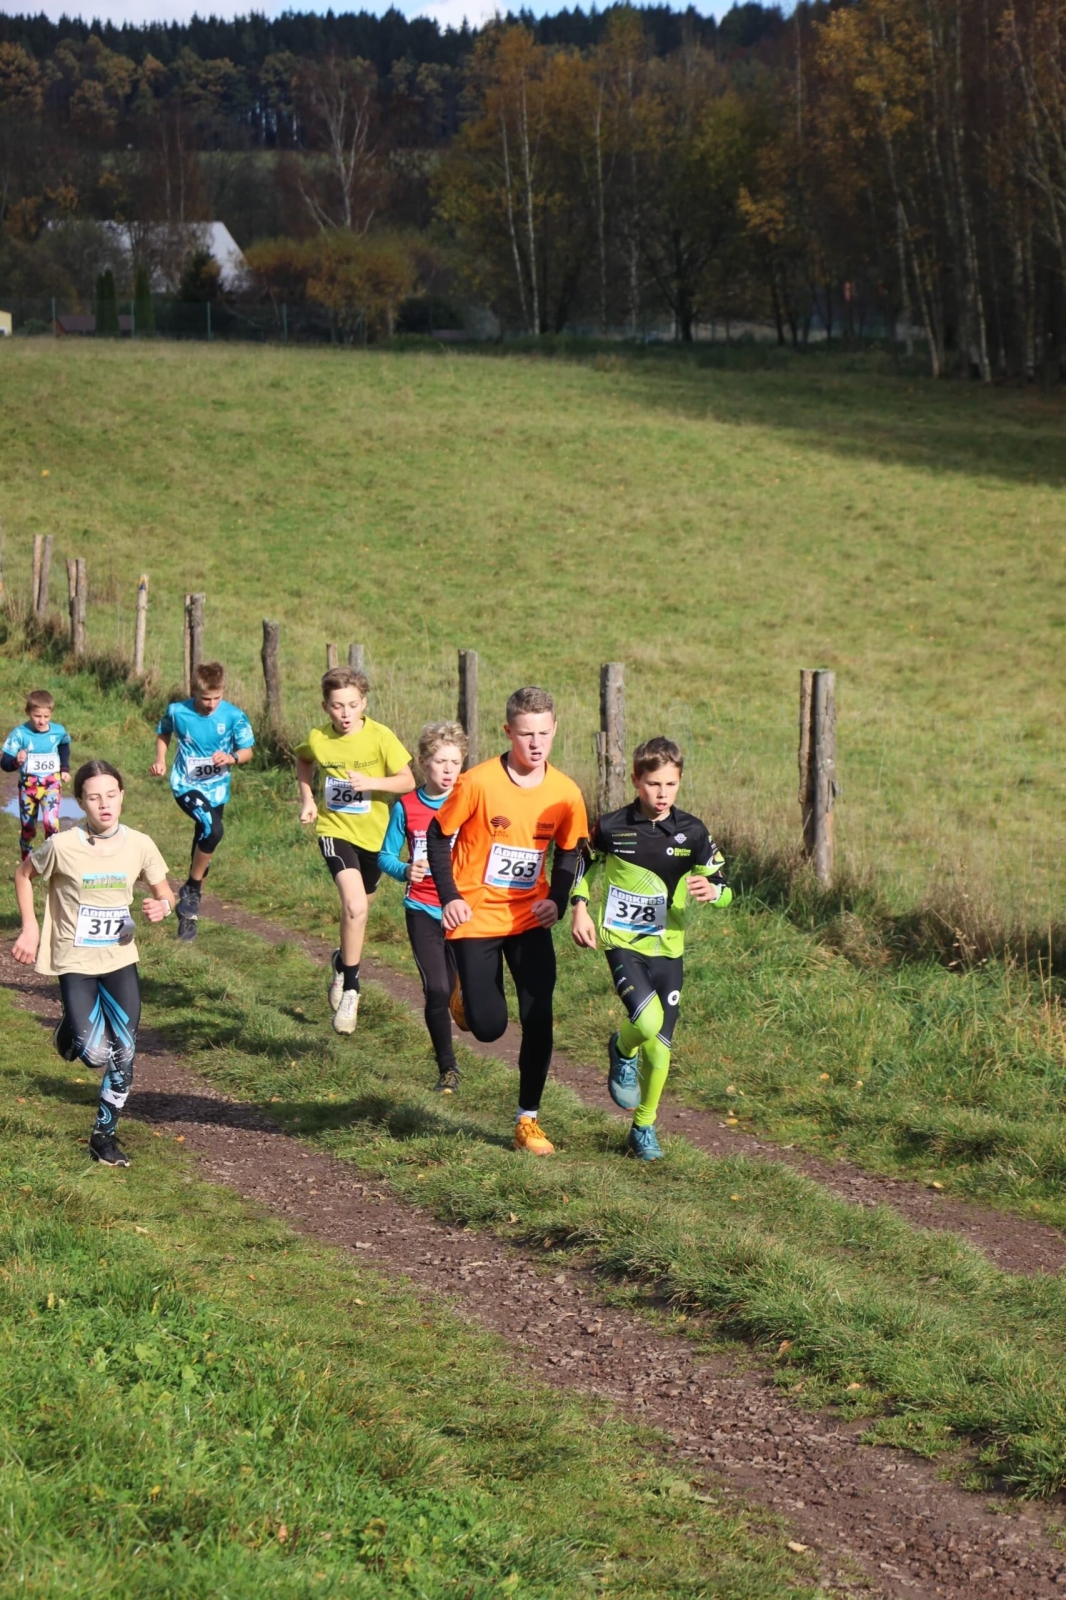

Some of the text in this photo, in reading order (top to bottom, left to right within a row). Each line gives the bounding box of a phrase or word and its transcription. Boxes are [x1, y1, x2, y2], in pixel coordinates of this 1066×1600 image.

[33, 760, 55, 771] 368
[195, 764, 221, 777] 308
[331, 787, 364, 804] 264
[497, 858, 537, 878] 263
[610, 887, 665, 905] ADRKROS
[616, 901, 656, 922] 378
[88, 918, 125, 936] 317
